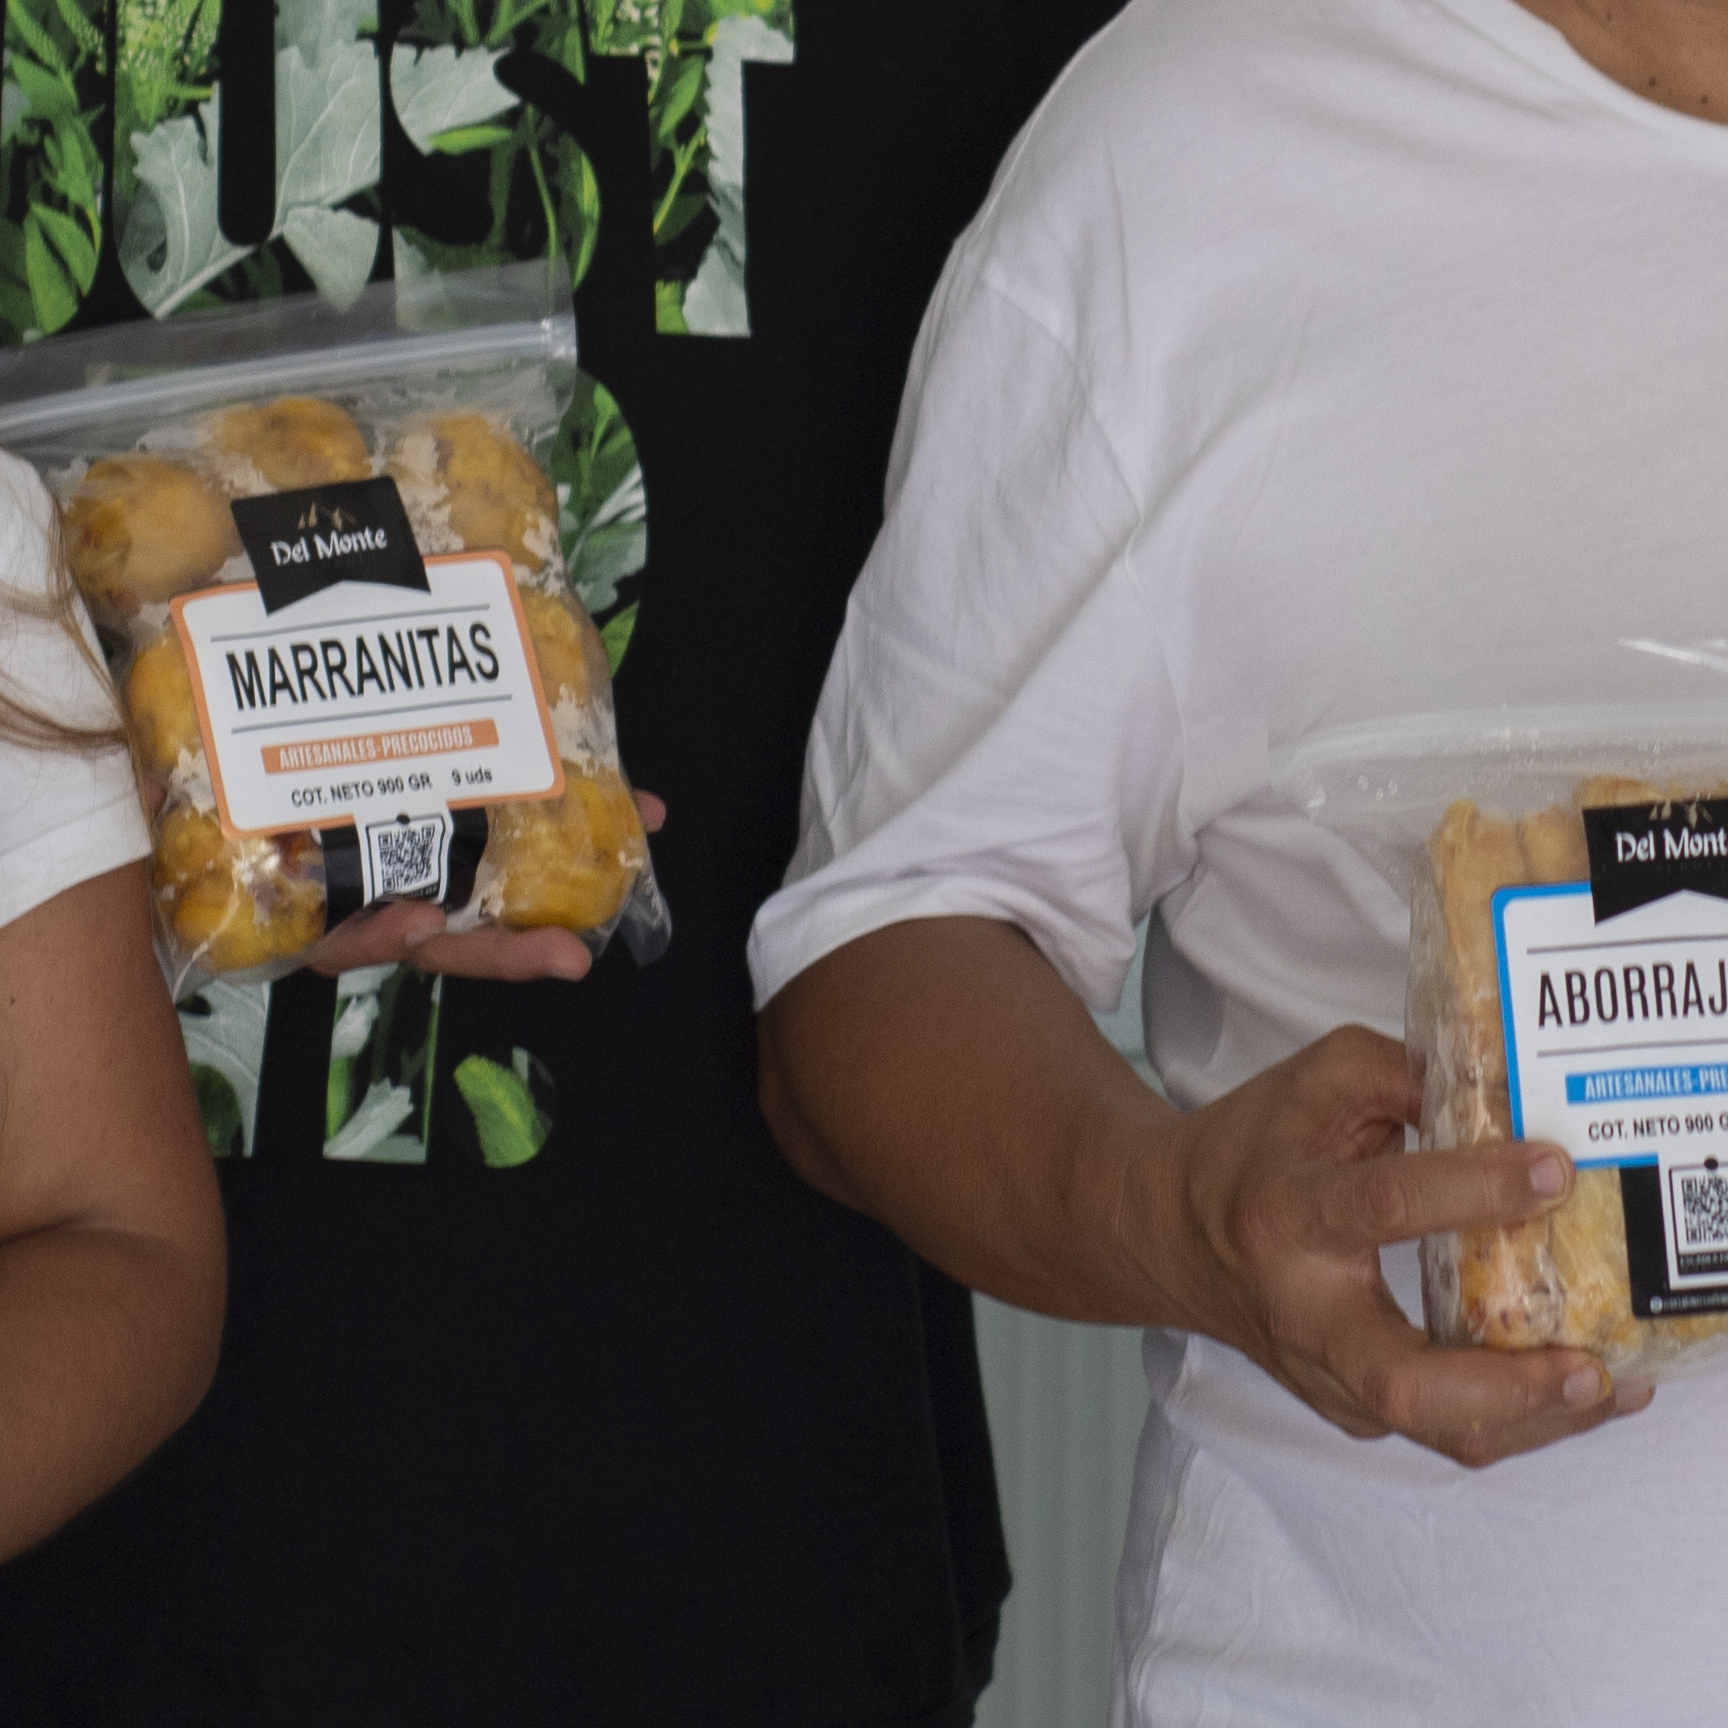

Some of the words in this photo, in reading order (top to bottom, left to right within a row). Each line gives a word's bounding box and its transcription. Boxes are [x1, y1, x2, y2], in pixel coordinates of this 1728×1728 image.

[270, 536, 311, 566] Del
[313, 526, 388, 560] Monte
[225, 621, 501, 712] MARRANITAS
[330, 780, 374, 802] NETO
[377, 776, 405, 795] 900
[408, 772, 433, 791] GR
[451, 768, 462, 786] 9
[465, 765, 493, 785] uds
[1615, 829, 1656, 863] Del
[1633, 1116, 1681, 1138] NETO
[1685, 1113, 1714, 1134] 900
